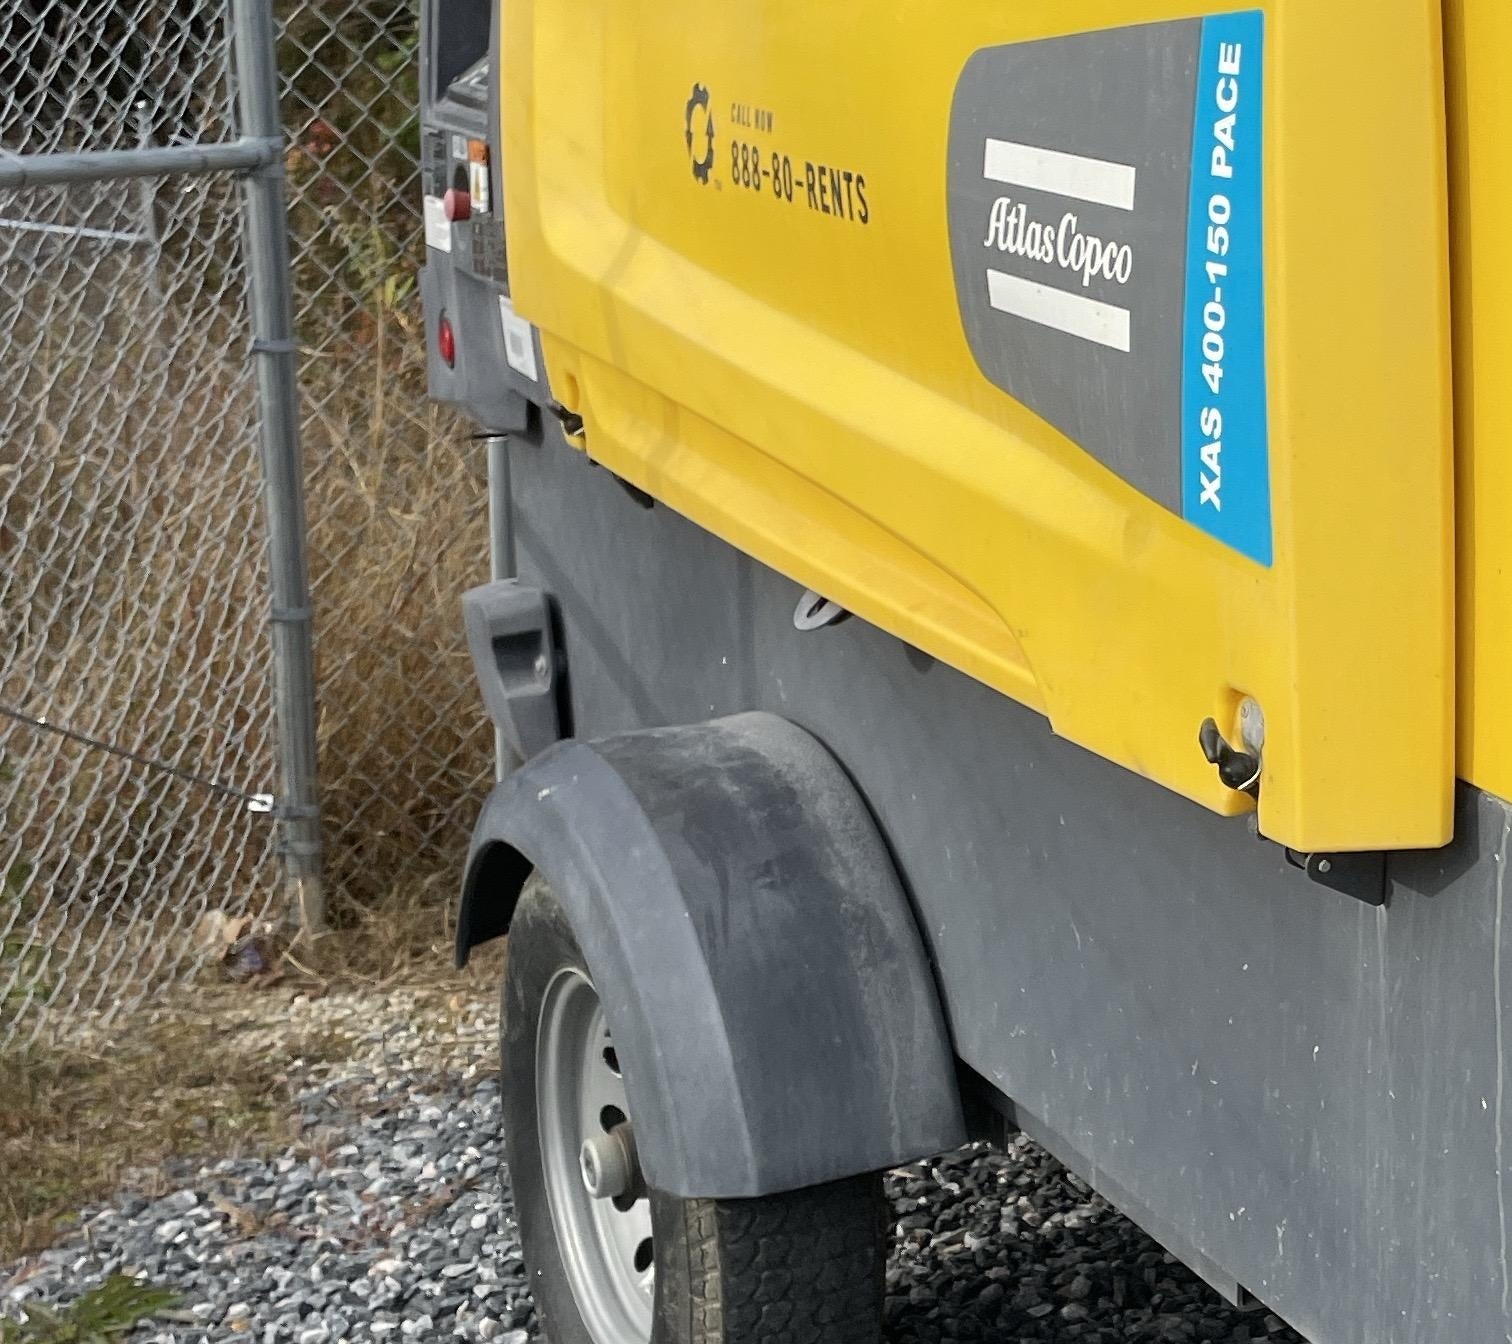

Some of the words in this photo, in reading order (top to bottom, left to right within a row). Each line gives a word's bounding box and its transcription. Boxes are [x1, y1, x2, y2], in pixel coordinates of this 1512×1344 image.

[731, 102, 751, 128] CALL
[1210, 41, 1243, 180] PACE
[731, 139, 869, 225] 888-80-RENTS
[983, 196, 1056, 264] Atlas
[1056, 212, 1133, 288] Copco
[1201, 193, 1233, 395] 400-150
[1200, 405, 1223, 512] XAS
